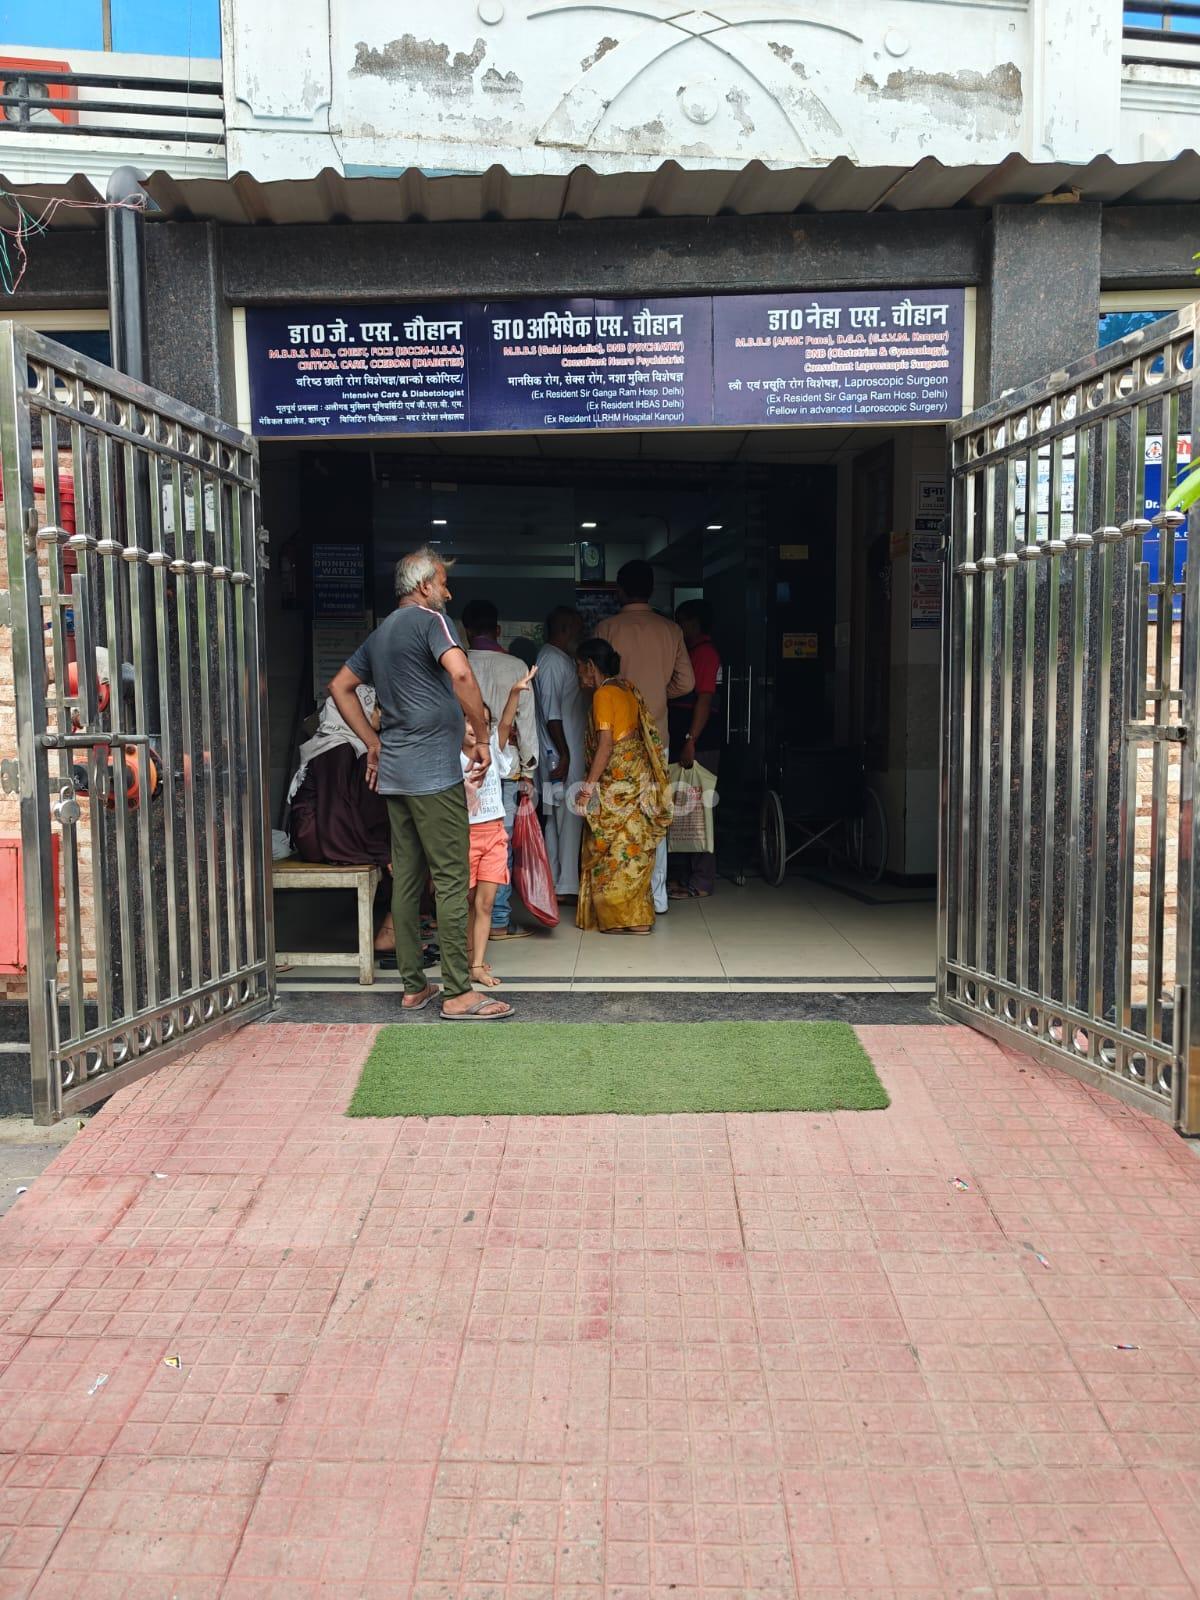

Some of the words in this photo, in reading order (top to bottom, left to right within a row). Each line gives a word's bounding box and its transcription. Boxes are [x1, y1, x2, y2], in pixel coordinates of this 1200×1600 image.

[806, 303, 841, 330] नेहा
[849, 306, 886, 328] एस.
[892, 299, 949, 325] चौहान
[360, 322, 398, 342] एस.
[404, 316, 462, 341] चौहान
[527, 311, 593, 339] अभिषेक
[595, 315, 628, 337] एस.
[632, 308, 683, 335] चौहान
[879, 347, 887, 356] &
[561, 357, 606, 367] Consultant
[804, 362, 853, 372] Consultant
[911, 359, 949, 370] Surgeon
[345, 375, 361, 385] रोग
[508, 374, 541, 386] मानसिक
[565, 372, 584, 384] सेक्स
[608, 373, 626, 383] नशा
[652, 370, 683, 383] विशेषज्ञ
[789, 377, 804, 389] रोग
[845, 375, 904, 389] Laproscopic
[907, 374, 948, 387] Surgeon
[411, 390, 464, 399] Diabetologist
[532, 391, 544, 400] (Ex
[546, 390, 578, 399] Resident
[580, 389, 590, 397] Sir
[592, 389, 617, 400] Ganga
[619, 388, 636, 397] Ram
[662, 387, 684, 396] Delhi)
[766, 394, 780, 404] (Ex
[785, 393, 822, 402] Resident
[824, 392, 836, 401] Sir
[838, 392, 868, 403] Ganga
[870, 391, 891, 400] Ram
[893, 390, 919, 401] Hosp.
[922, 389, 948, 400] Delhi)
[587, 402, 599, 411] (Ex
[601, 401, 634, 410] Resident
[635, 400, 660, 409] IHBAS
[662, 400, 684, 410] Delhi)
[766, 405, 797, 417] (Fellow
[800, 406, 808, 414] in
[810, 404, 852, 414] advanced
[855, 402, 907, 414] Laproscopic
[909, 401, 948, 413] Surgery)
[544, 415, 557, 425] (Ex
[558, 414, 591, 423] Resident
[593, 413, 621, 422] LLRHM
[623, 413, 653, 423] Hospital
[655, 412, 684, 423] Kanpur)
[1145, 499, 1160, 509] Dr.
[315, 560, 364, 568] DRINKING
[322, 567, 357, 575] WATER
